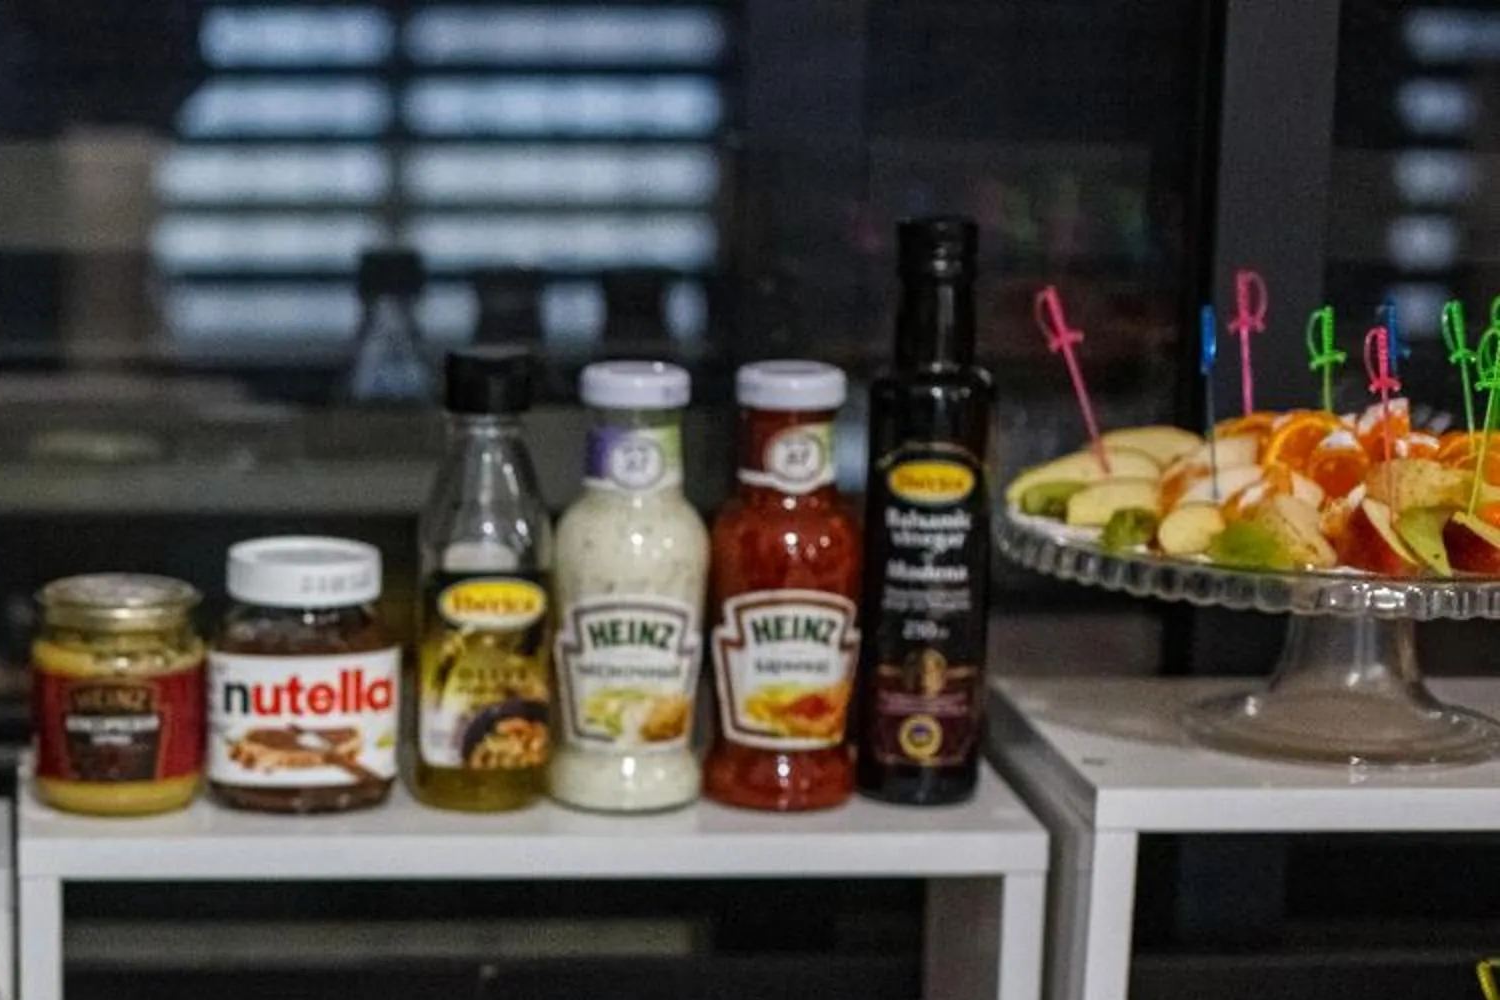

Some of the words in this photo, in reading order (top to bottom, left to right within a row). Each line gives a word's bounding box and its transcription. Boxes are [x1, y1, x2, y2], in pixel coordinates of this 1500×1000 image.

[587, 619, 675, 650] HEINZ
[751, 615, 837, 646] HEINZ
[223, 670, 393, 717] nutella
